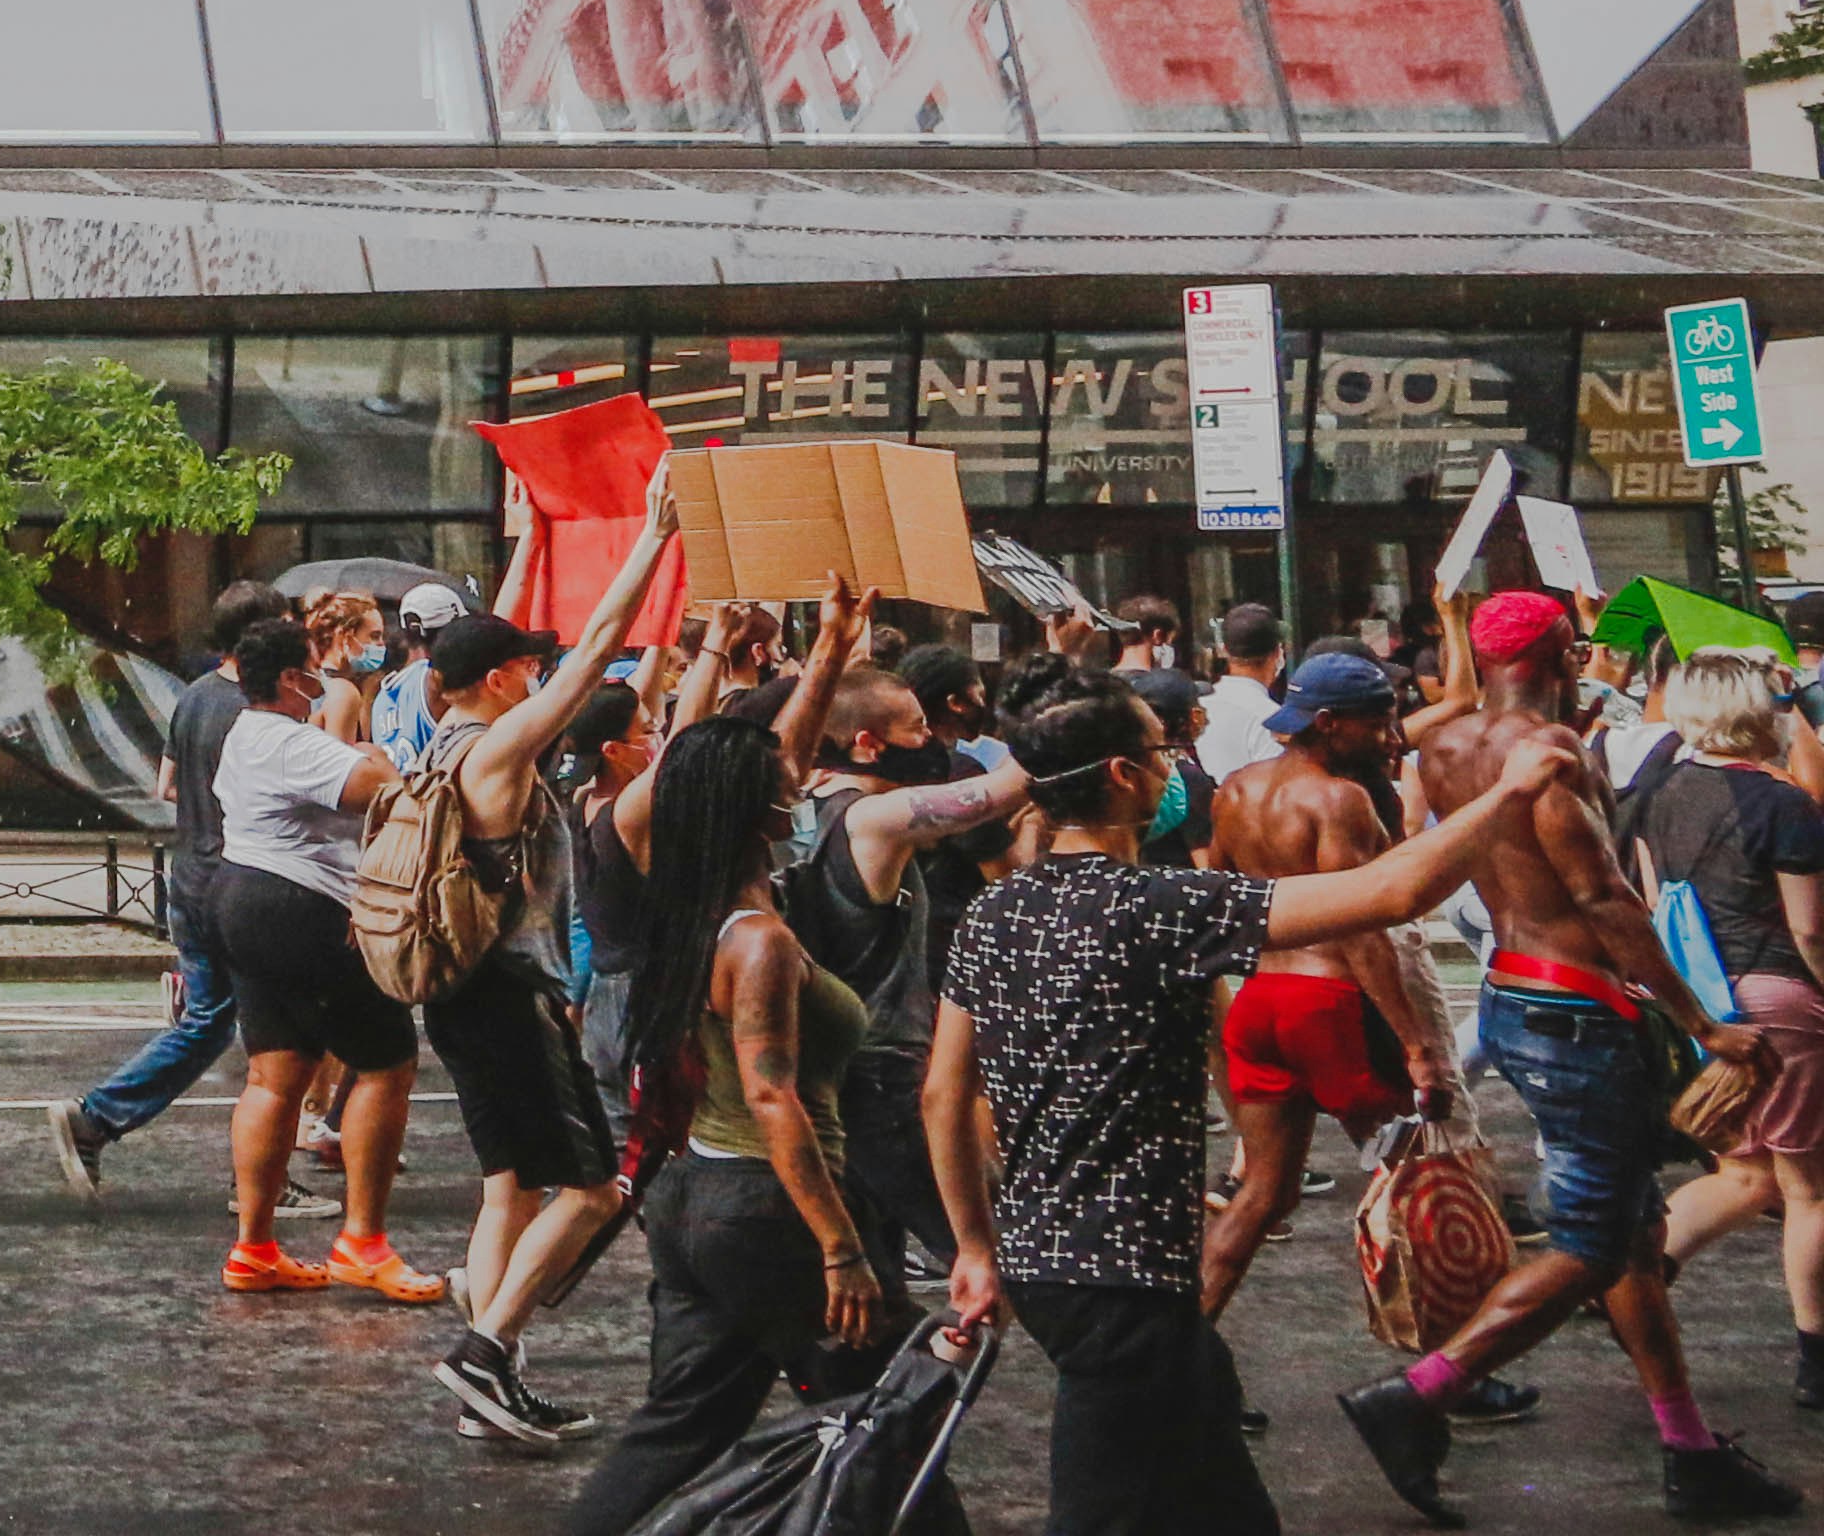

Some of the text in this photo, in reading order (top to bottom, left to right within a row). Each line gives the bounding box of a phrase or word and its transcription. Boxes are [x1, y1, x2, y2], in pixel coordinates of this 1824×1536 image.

[1193, 292, 1209, 313] 3
[1191, 318, 1254, 330] COMMERCIAL
[1193, 330, 1239, 343] VEHICLES
[1694, 364, 1734, 385] West
[729, 357, 1508, 417] THE NEW SOOL
[1578, 371, 1667, 414] NE
[1700, 392, 1738, 412] Side
[1198, 405, 1216, 428] 2
[1589, 429, 1683, 456] SINCE
[1055, 455, 1191, 473] UNIVERSITY
[1612, 463, 1708, 498] 1919
